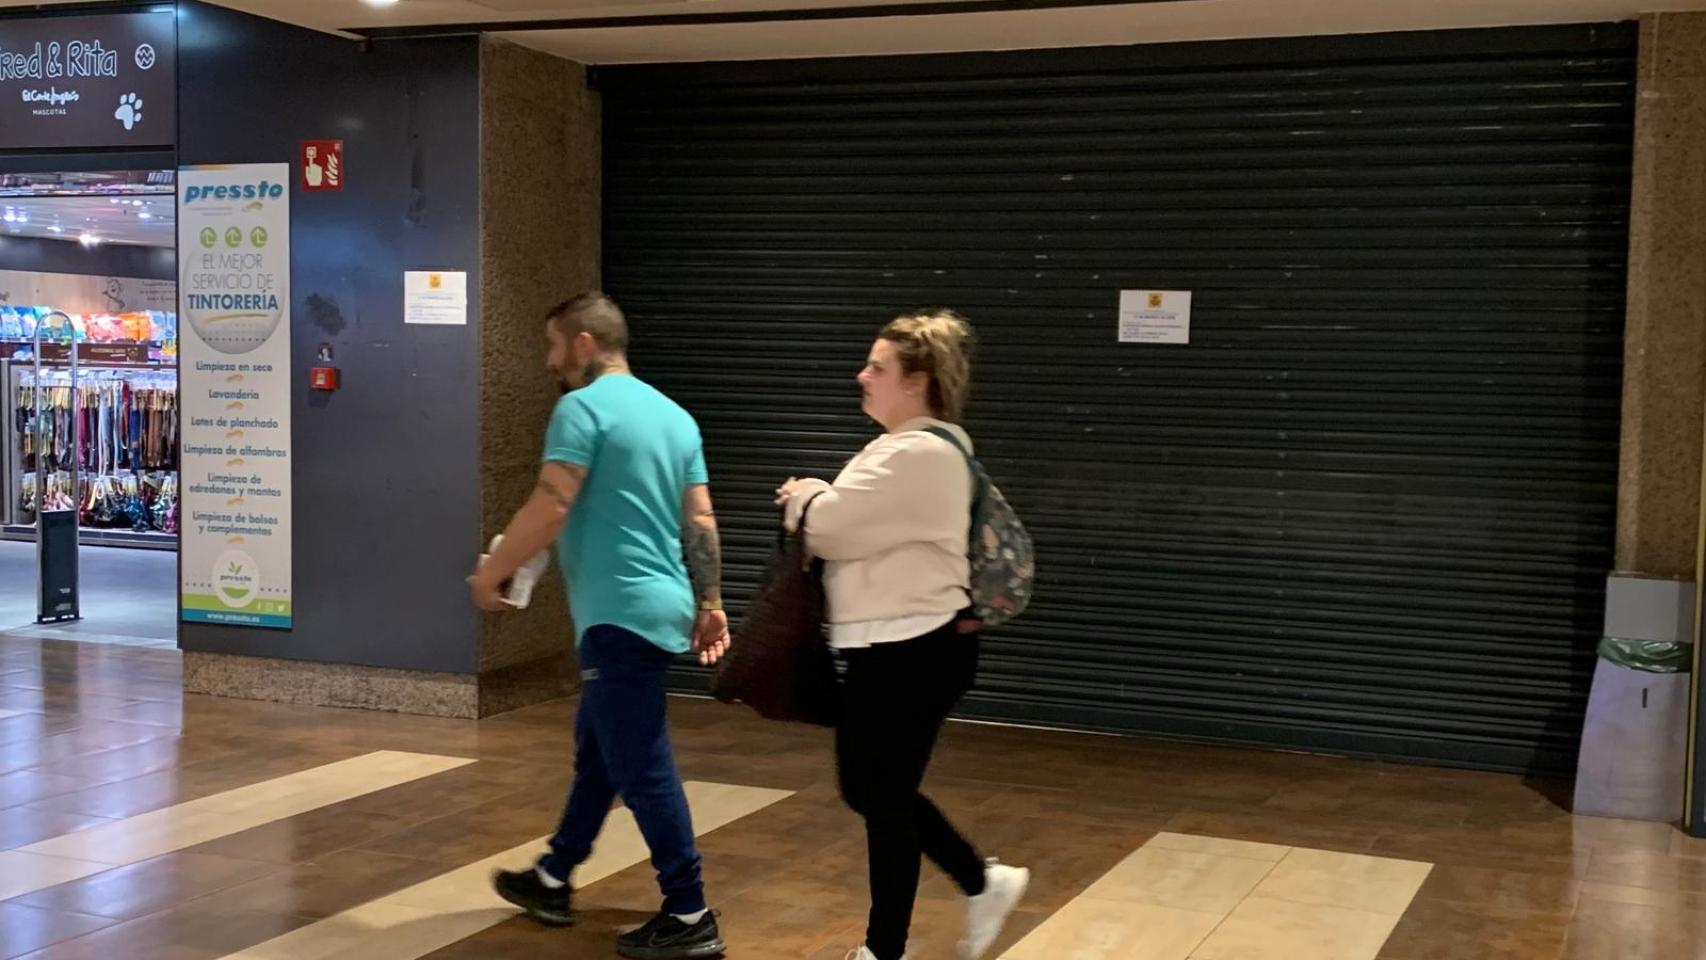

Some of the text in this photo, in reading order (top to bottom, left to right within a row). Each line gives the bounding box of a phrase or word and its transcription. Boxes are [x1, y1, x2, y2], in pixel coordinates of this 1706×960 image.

[46, 41, 63, 78] &
[67, 39, 118, 78] Rita
[32, 108, 67, 116] MASCOTAS
[184, 180, 283, 204] pressto
[202, 253, 263, 272] EL MEJOR
[192, 273, 274, 290] SERVICIO DE
[187, 289, 279, 310] TINTORERÍA
[196, 361, 236, 373] Limpieza
[252, 364, 273, 372] seco
[216, 417, 228, 428] de
[230, 417, 279, 430] planchado
[183, 444, 287, 457] Limpieza de alfombras
[207, 473, 262, 486] Limpieza de
[188, 483, 236, 495] edredones
[247, 488, 281, 497] mantas
[192, 510, 278, 525] Limpieza de bolsas
[207, 524, 272, 536] complementos
